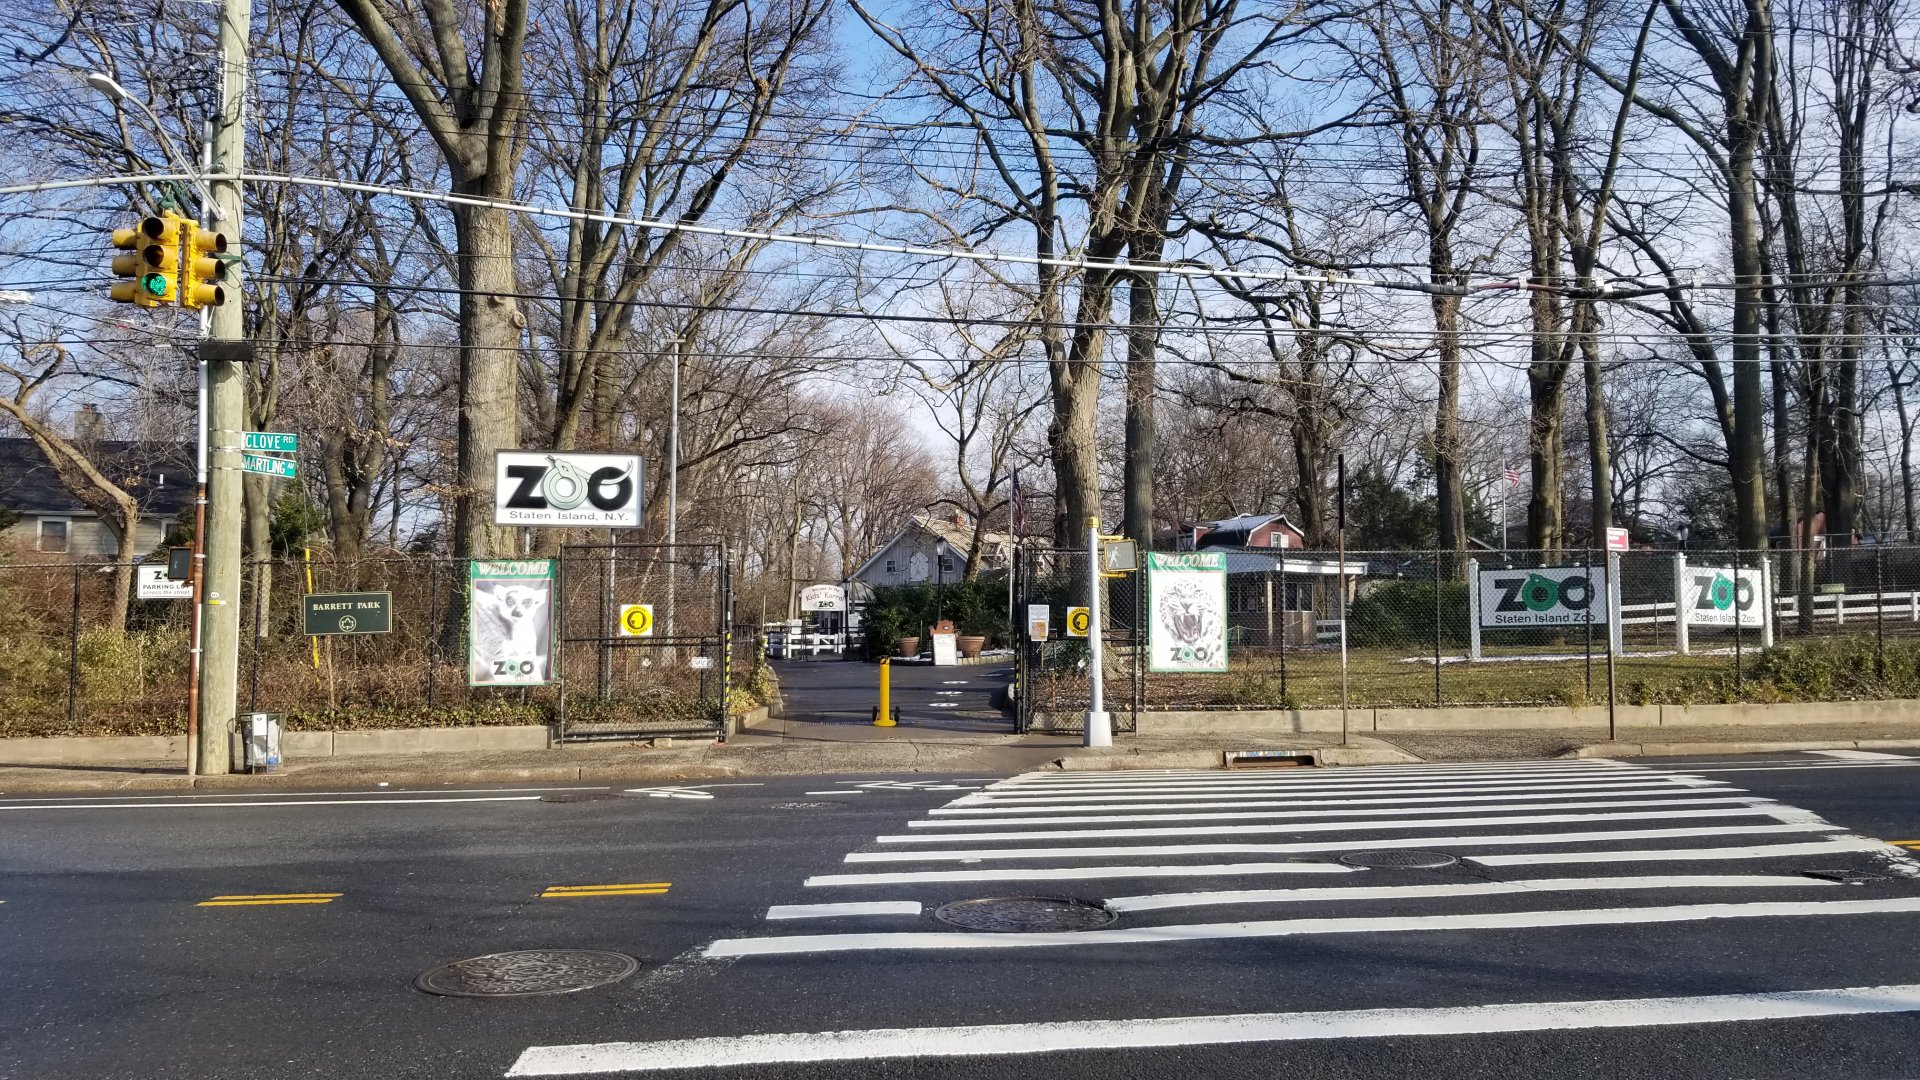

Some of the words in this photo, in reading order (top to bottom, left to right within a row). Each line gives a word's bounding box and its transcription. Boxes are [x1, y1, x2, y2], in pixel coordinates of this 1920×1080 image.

[246, 434, 280, 449] CLOVE
[243, 456, 286, 474] MARTLING
[505, 460, 633, 511] ZOO
[510, 511, 551, 519] Staten
[558, 512, 598, 521] Island,
[605, 513, 629, 521] N.Y.
[1155, 554, 1220, 567] WELCOME
[479, 562, 550, 575] WELCOME
[1494, 572, 1595, 611] ZOO
[1695, 572, 1754, 611] ZOO
[1496, 614, 1531, 624] Staten
[1535, 613, 1570, 623] Island
[1574, 613, 1596, 622] Zoo
[1696, 613, 1718, 622] Staten
[1170, 646, 1208, 661] ZOO
[494, 660, 534, 675] ZOO
